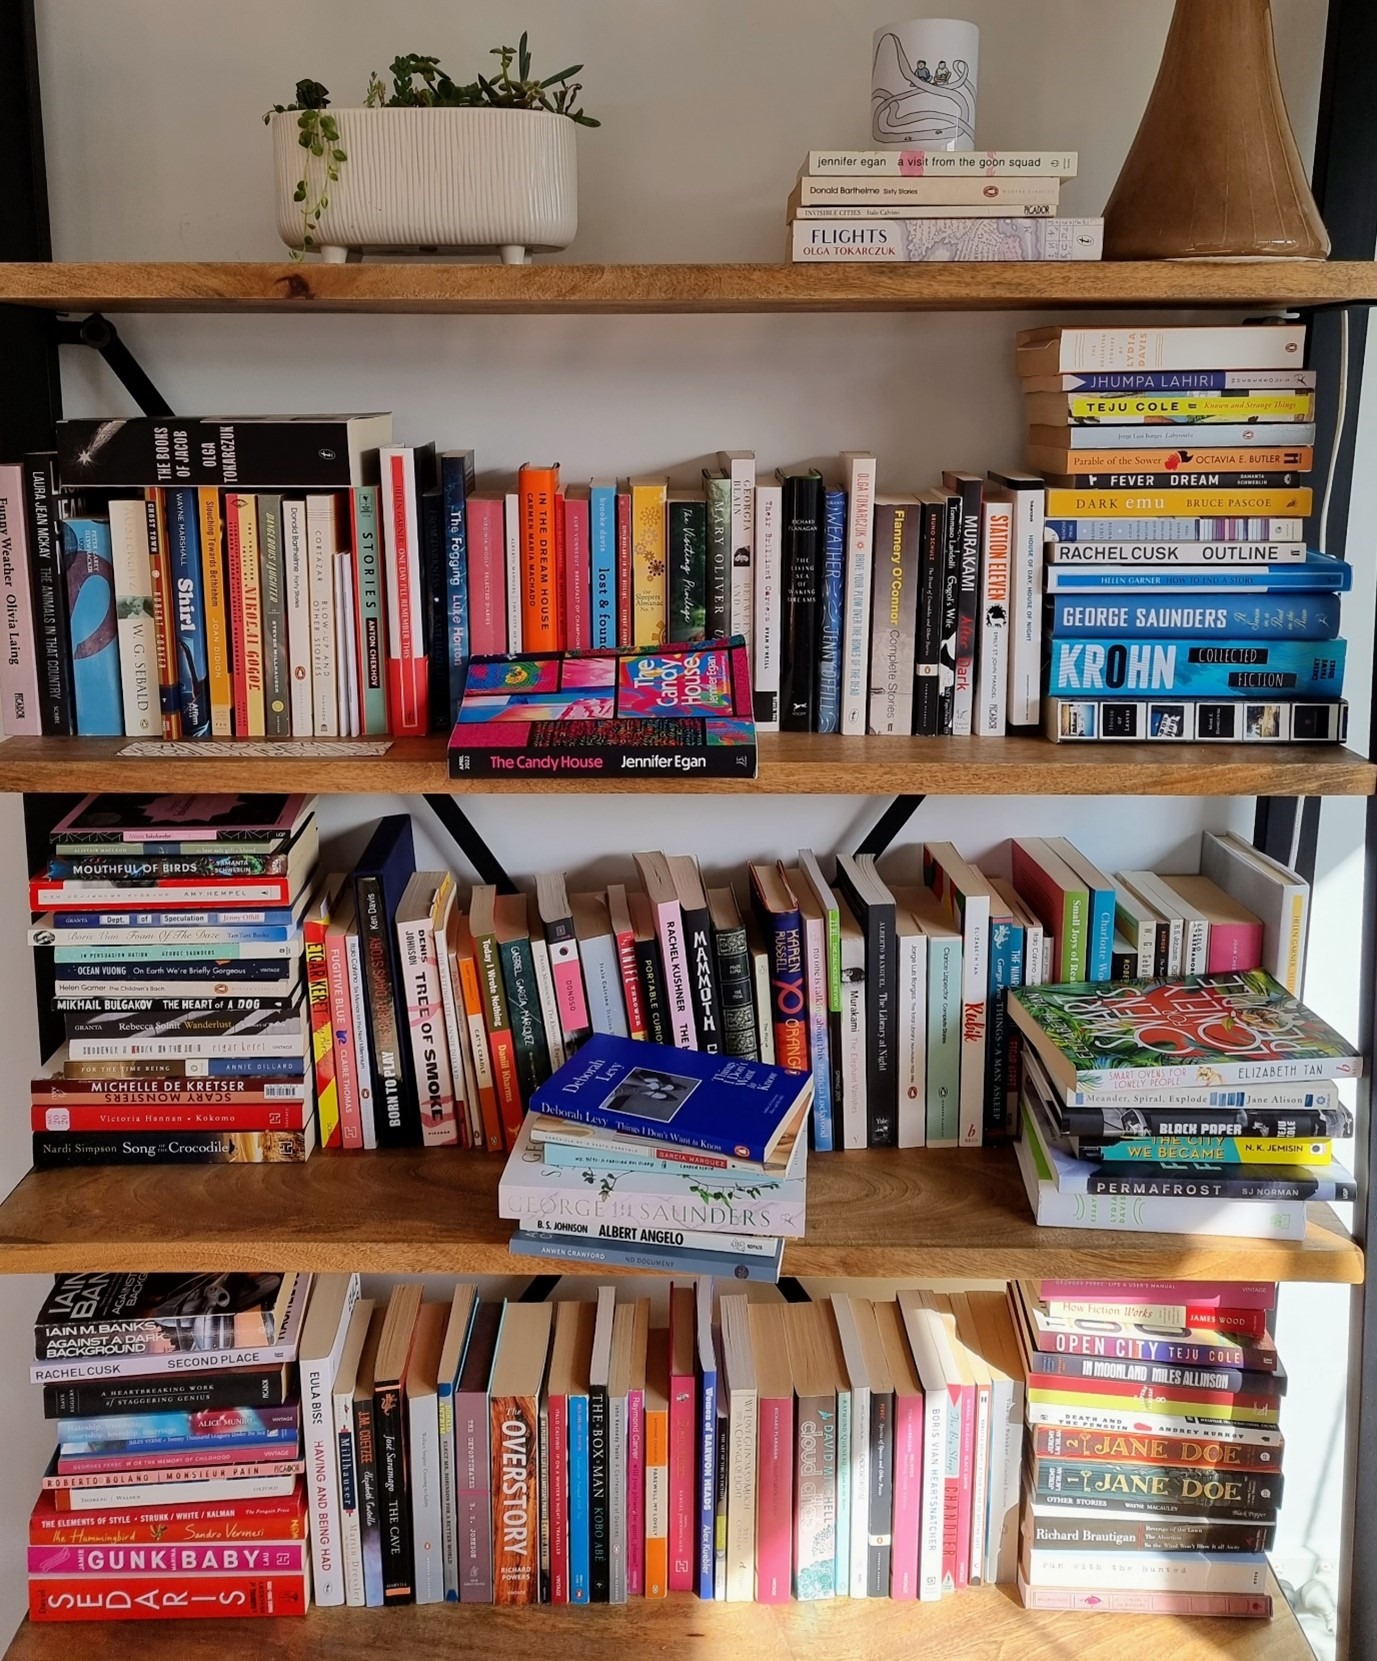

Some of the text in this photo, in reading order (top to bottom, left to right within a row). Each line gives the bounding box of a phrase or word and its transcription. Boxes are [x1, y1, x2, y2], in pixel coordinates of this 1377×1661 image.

[818, 156, 1041, 168] jennifer egan a visit from the goon squad
[811, 229, 887, 244] FLIGHTS
[803, 247, 895, 255] OLGA TOKARCZUK
[1091, 376, 1214, 388] JHUMPA LAHIRI
[1087, 402, 1179, 412] TEJU COLE
[155, 427, 171, 480] THE BOOKS
[174, 430, 190, 477] OF JACOB
[203, 442, 216, 467] OLGA
[221, 426, 238, 483] TOKARCZUK
[1074, 456, 1161, 466] Parable of the Sower
[1110, 475, 1218, 486] FEVER DREAM
[539, 493, 546, 504] IN
[1076, 497, 1165, 509] DARK emu
[540, 540, 548, 582] DREAM
[713, 501, 725, 614] MARY OLIVER
[961, 515, 978, 592] MURAKAMI
[988, 515, 1009, 600] STATION ELEVEN
[1060, 547, 1178, 559] RACHEL CUSK
[1202, 547, 1278, 559] OUTLINE
[363, 532, 375, 609] STORIES
[891, 510, 904, 625] Flannery O'Connor
[178, 578, 195, 631] Shirl
[541, 589, 549, 630] HOUSE
[1063, 607, 1226, 628] GEORGE SAUNDERS
[368, 621, 378, 686] ANTON CHEKHOV
[1199, 648, 1257, 662] COLLECTED
[634, 660, 654, 688] The
[1059, 644, 1176, 689] KROHN
[657, 659, 681, 707] Candy
[682, 658, 699, 705] House
[1238, 673, 1283, 686] FICTION
[491, 756, 603, 771] The Candy House
[621, 755, 706, 770] Jennifer Egan
[73, 863, 197, 875] MOUTHFUL OF BIRDS
[164, 914, 204, 923] Speculation
[775, 931, 787, 972] RUSSELL
[787, 929, 800, 973] KAREN
[78, 966, 126, 976] OCEAN VUONG
[133, 966, 245, 976] On Earth We're Briefly Gorgeous
[667, 921, 685, 1013] RACHEL KUSHNER
[694, 931, 715, 1031] MAMMOTH
[57, 1000, 152, 1010] MIKHAIL BULGAKOV
[163, 1000, 179, 1009] THE
[182, 1000, 212, 1009] HEART
[228, 1000, 233, 1009] A
[237, 999, 260, 1009] DOG
[184, 1020, 231, 1030] Wanderlust
[964, 1002, 984, 1042] Kubik
[415, 972, 443, 1121] TREE OF SMOKE
[1239, 1064, 1323, 1079] ELIZABETH TAN
[91, 1081, 244, 1092] MICHELLE DE KRETSER
[105, 1093, 231, 1102] SCARY MONSTERS
[1087, 1094, 1207, 1104] Meander, Spiral, Explode
[542, 1103, 607, 1126] Deborah Levy
[1159, 1123, 1242, 1135] BLACK PAPER
[123, 1142, 156, 1156] Song
[168, 1141, 228, 1153] Crocodile
[1097, 1183, 1221, 1196] PERMAFROST
[599, 1225, 683, 1245] ALBERT ANGELO
[542, 1248, 605, 1259] ANWEN CRAWFORD
[46, 1322, 156, 1336] IAIN M. BANKS
[47, 1333, 164, 1349] AGAINST A DARK
[1056, 1335, 1158, 1359] OPEN CITY
[46, 1344, 145, 1358] BACKGROUND
[168, 1353, 259, 1368] SECOND PLACE
[36, 1365, 120, 1380] RACHEL CUSK
[1083, 1360, 1092, 1376] IN
[1094, 1362, 1147, 1381] MOONLAND
[1152, 1367, 1228, 1389] MILES ALLINSON
[932, 1409, 940, 1440] BORIS
[592, 1394, 603, 1498] THE BOX MAN
[1095, 1437, 1241, 1464] JANE DOE
[47, 1472, 149, 1486] ROBERTO BOLAÑO
[501, 1420, 527, 1556] OVERSTORY
[1095, 1474, 1242, 1500] JANE DOE
[315, 1441, 331, 1572] HAVING AND BEING HAD
[929, 1469, 938, 1551] HEARTSNATCHER
[58, 1518, 95, 1527] ELEMENTS
[108, 1516, 130, 1524] STYLE
[944, 1487, 957, 1556] CHANDLER
[1037, 1528, 1136, 1545] Richard Brautigan
[88, 1550, 259, 1569] GUNK BABY
[48, 1590, 245, 1610] SEDARIS
